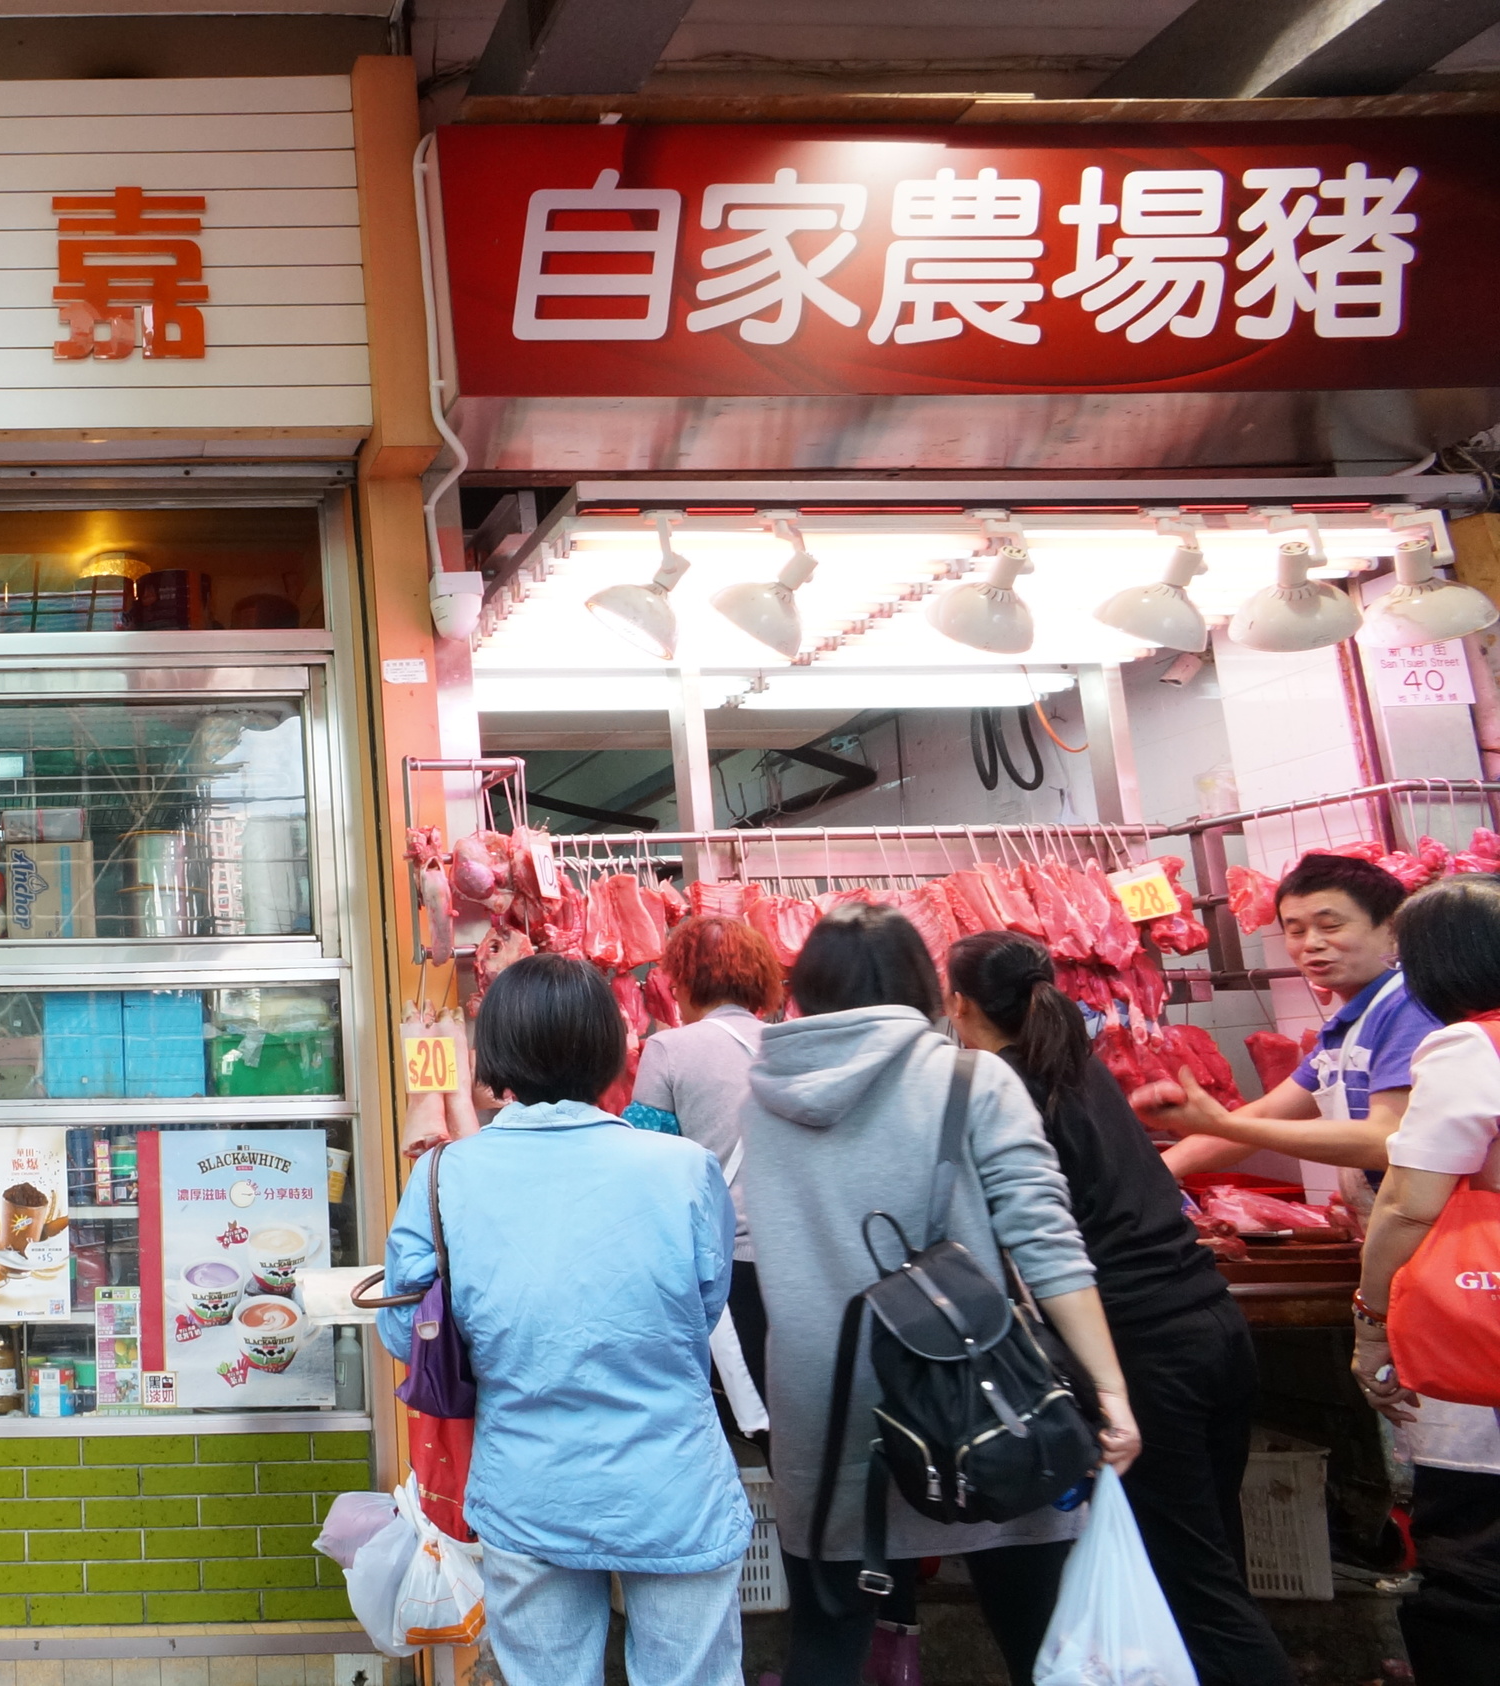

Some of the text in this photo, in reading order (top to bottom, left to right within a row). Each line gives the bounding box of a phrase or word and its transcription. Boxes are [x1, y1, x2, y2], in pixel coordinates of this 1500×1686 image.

[511, 162, 1419, 346] 自家農場豬
[1381, 658, 1460, 668] San Tsuen Street
[1404, 670, 1445, 691] 40
[10, 848, 37, 930] Anchor
[177, 1188, 227, 1201] 濃厚滋味
[264, 1187, 313, 1200] 分享時刻
[149, 1390, 174, 1403] 淡奶
